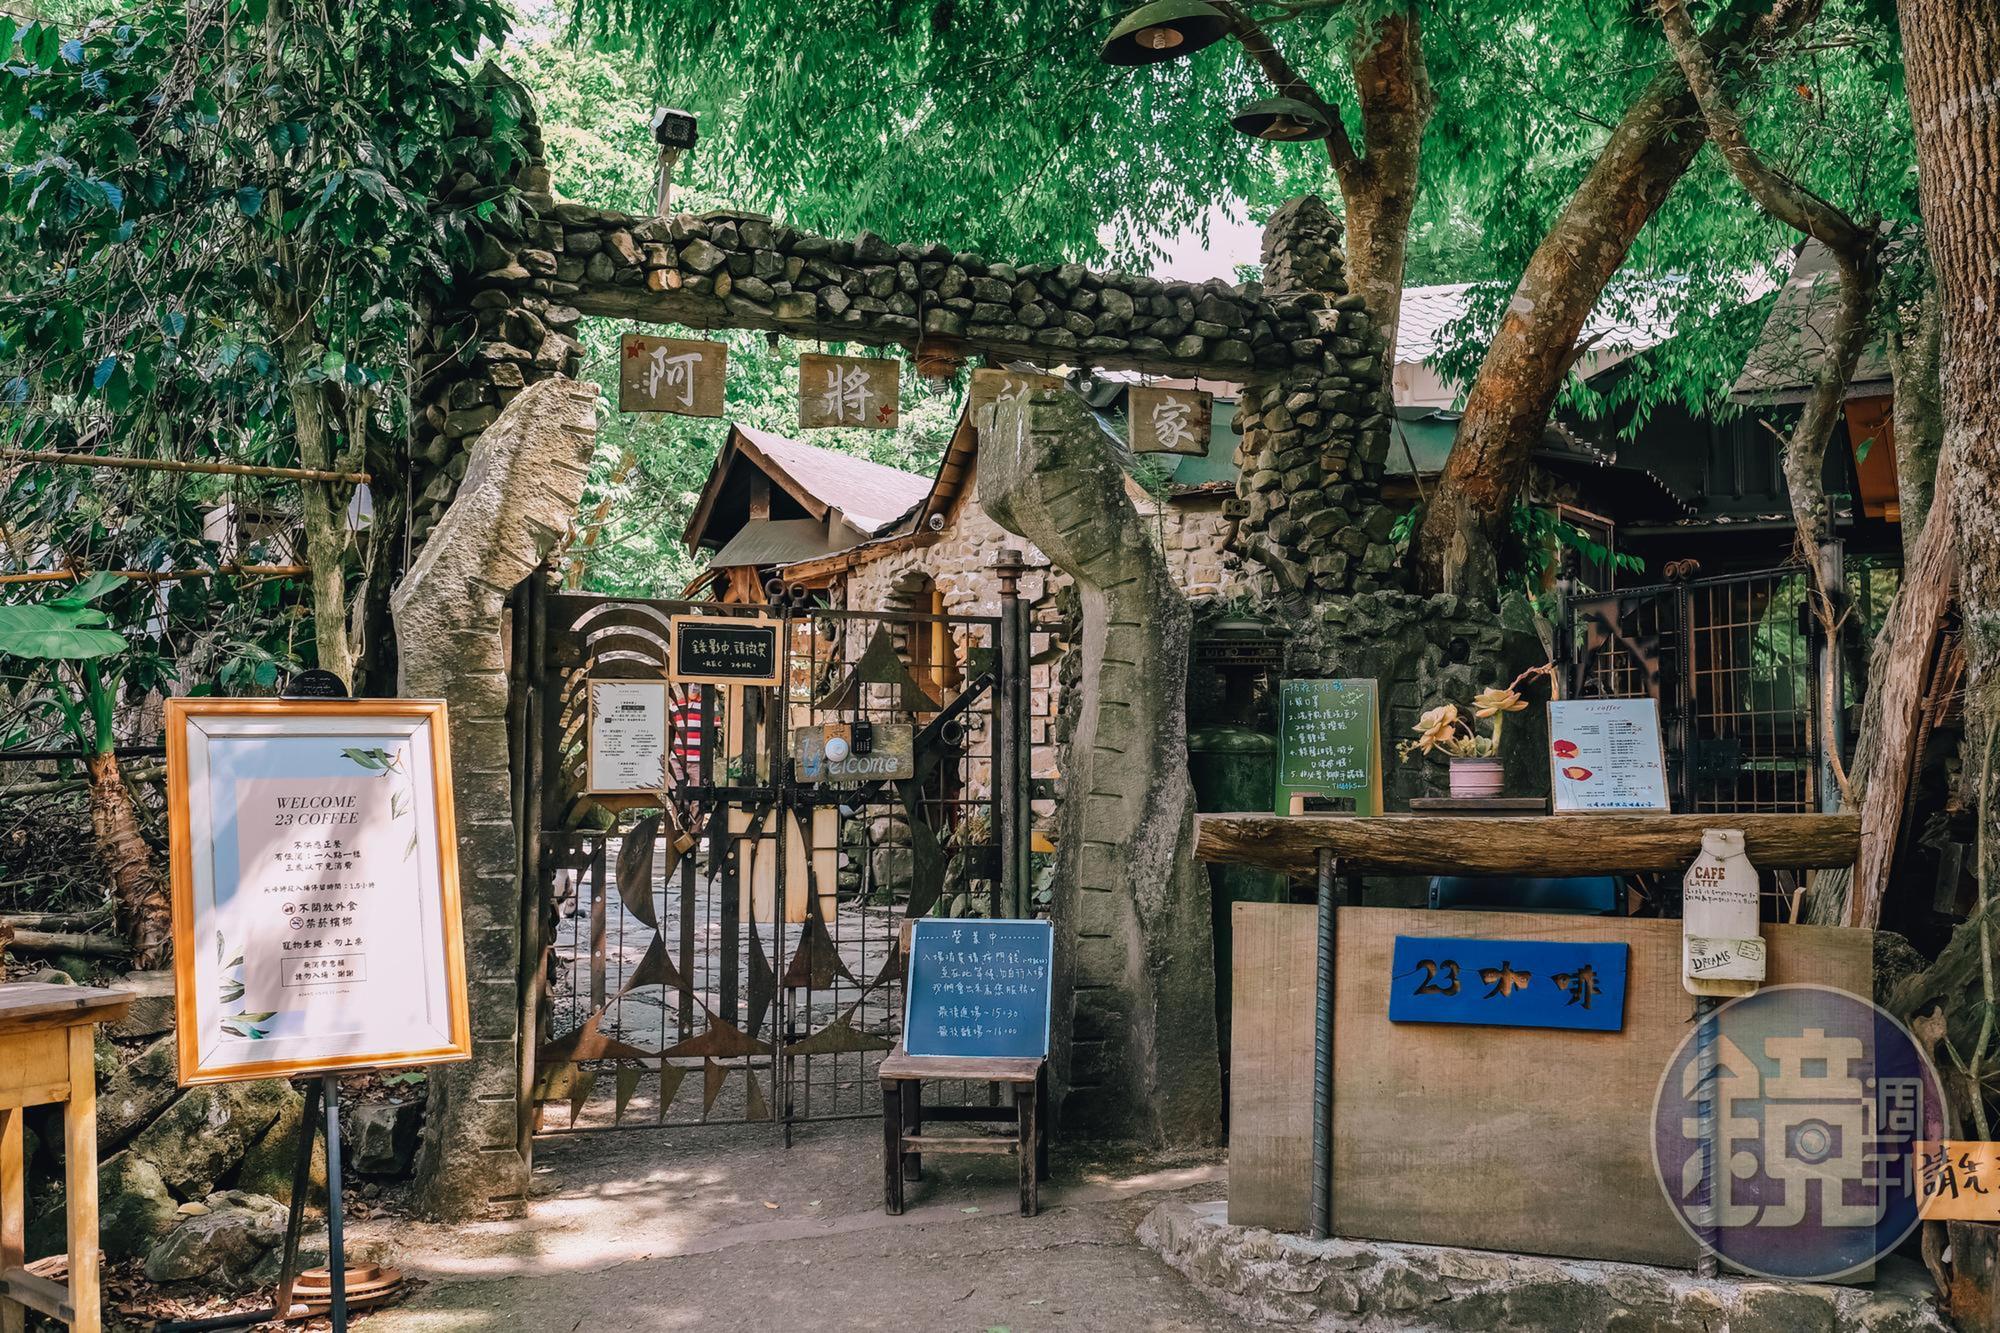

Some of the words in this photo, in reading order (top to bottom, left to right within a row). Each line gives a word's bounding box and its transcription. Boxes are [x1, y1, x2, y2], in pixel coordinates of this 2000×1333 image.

[647, 346, 702, 407] 阿
[822, 364, 873, 421] 將
[1152, 396, 1194, 448] 家
[276, 796, 356, 809] WELCOME
[275, 814, 294, 826] 23
[298, 812, 359, 825] COFFEE
[1695, 866, 1725, 880] CAFE
[1689, 879, 1718, 887] LATTE
[1414, 959, 1460, 996] 23
[1918, 1144, 2000, 1199] 請先
